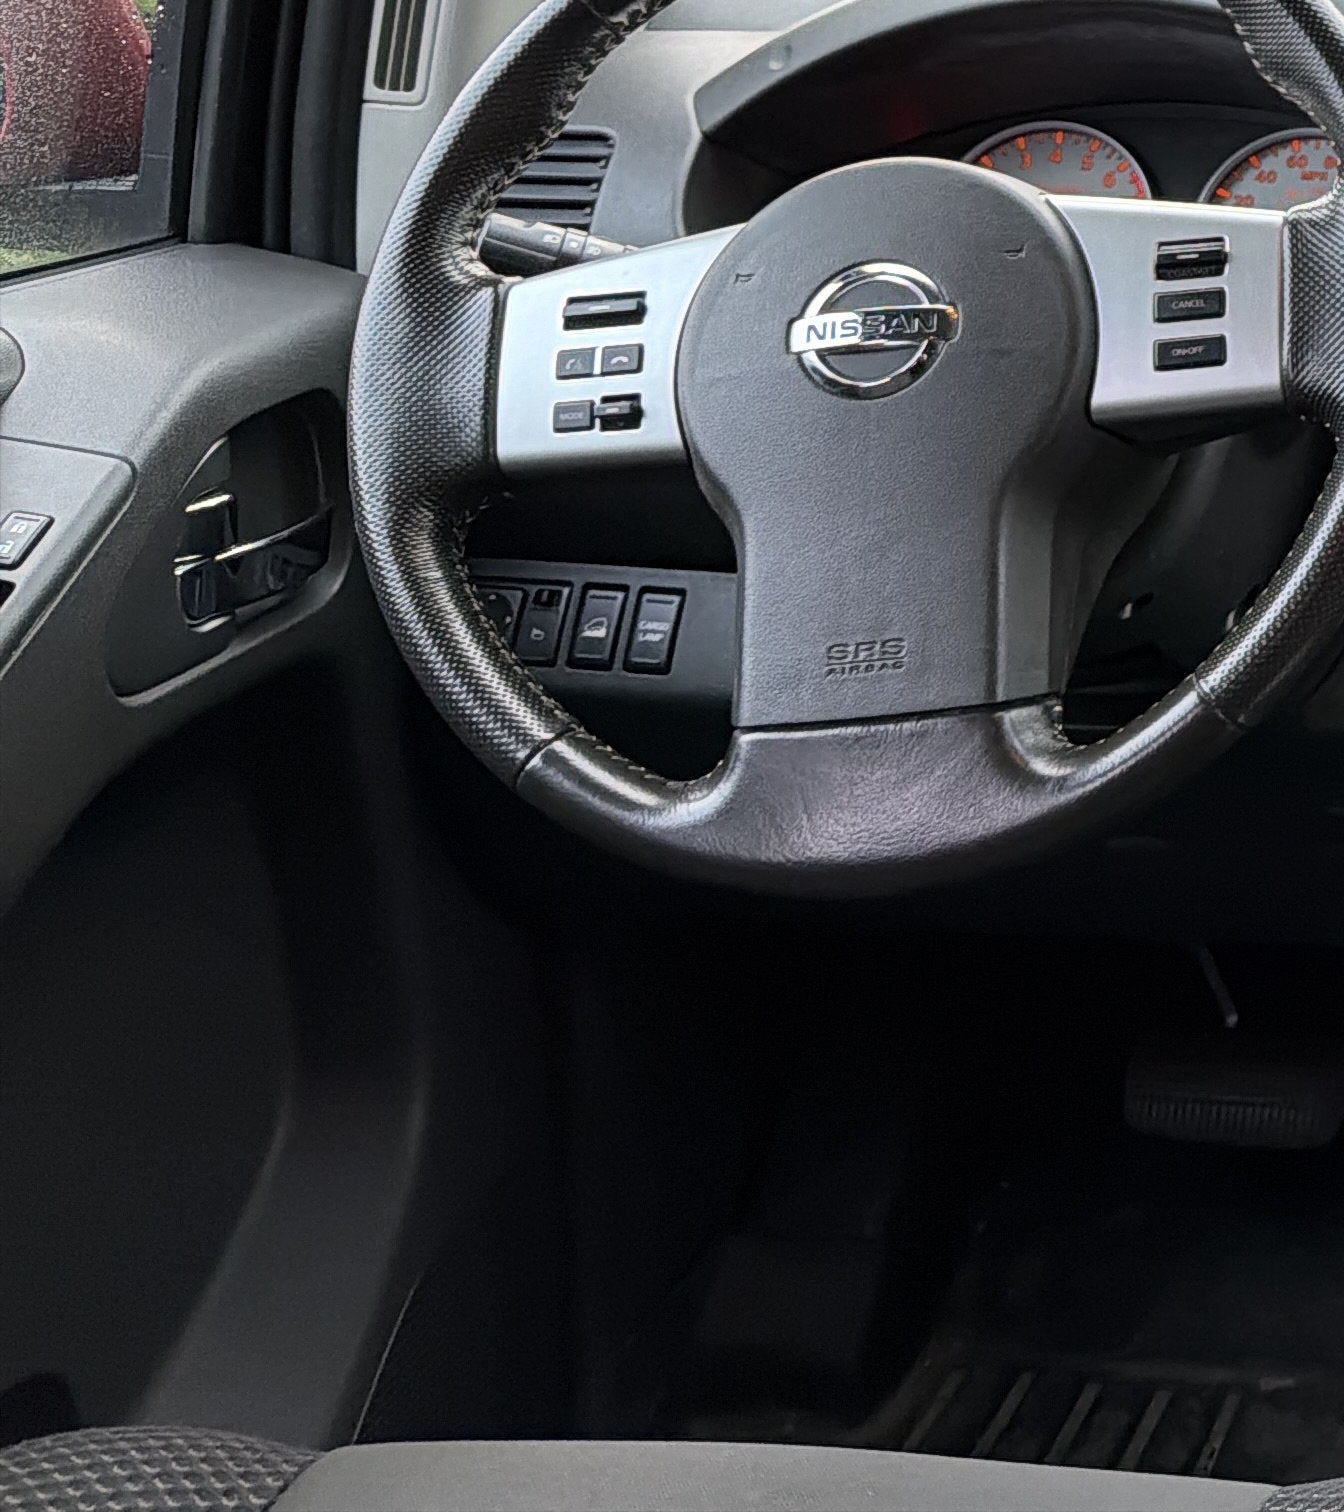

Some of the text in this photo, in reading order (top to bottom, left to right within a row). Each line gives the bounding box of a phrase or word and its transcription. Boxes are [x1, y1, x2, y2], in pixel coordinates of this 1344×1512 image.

[1020, 151, 1032, 169] 3
[1049, 148, 1062, 164] 4
[1081, 153, 1093, 170] 5
[1286, 155, 1308, 169] 60
[1103, 171, 1116, 188] 6
[1254, 170, 1277, 184] 40
[1171, 298, 1206, 310] CANCEL
[806, 312, 938, 344] NISSAN
[638, 632, 664, 642] LAMP
[826, 637, 908, 661] SRS
[824, 661, 907, 679] AIRBAG
